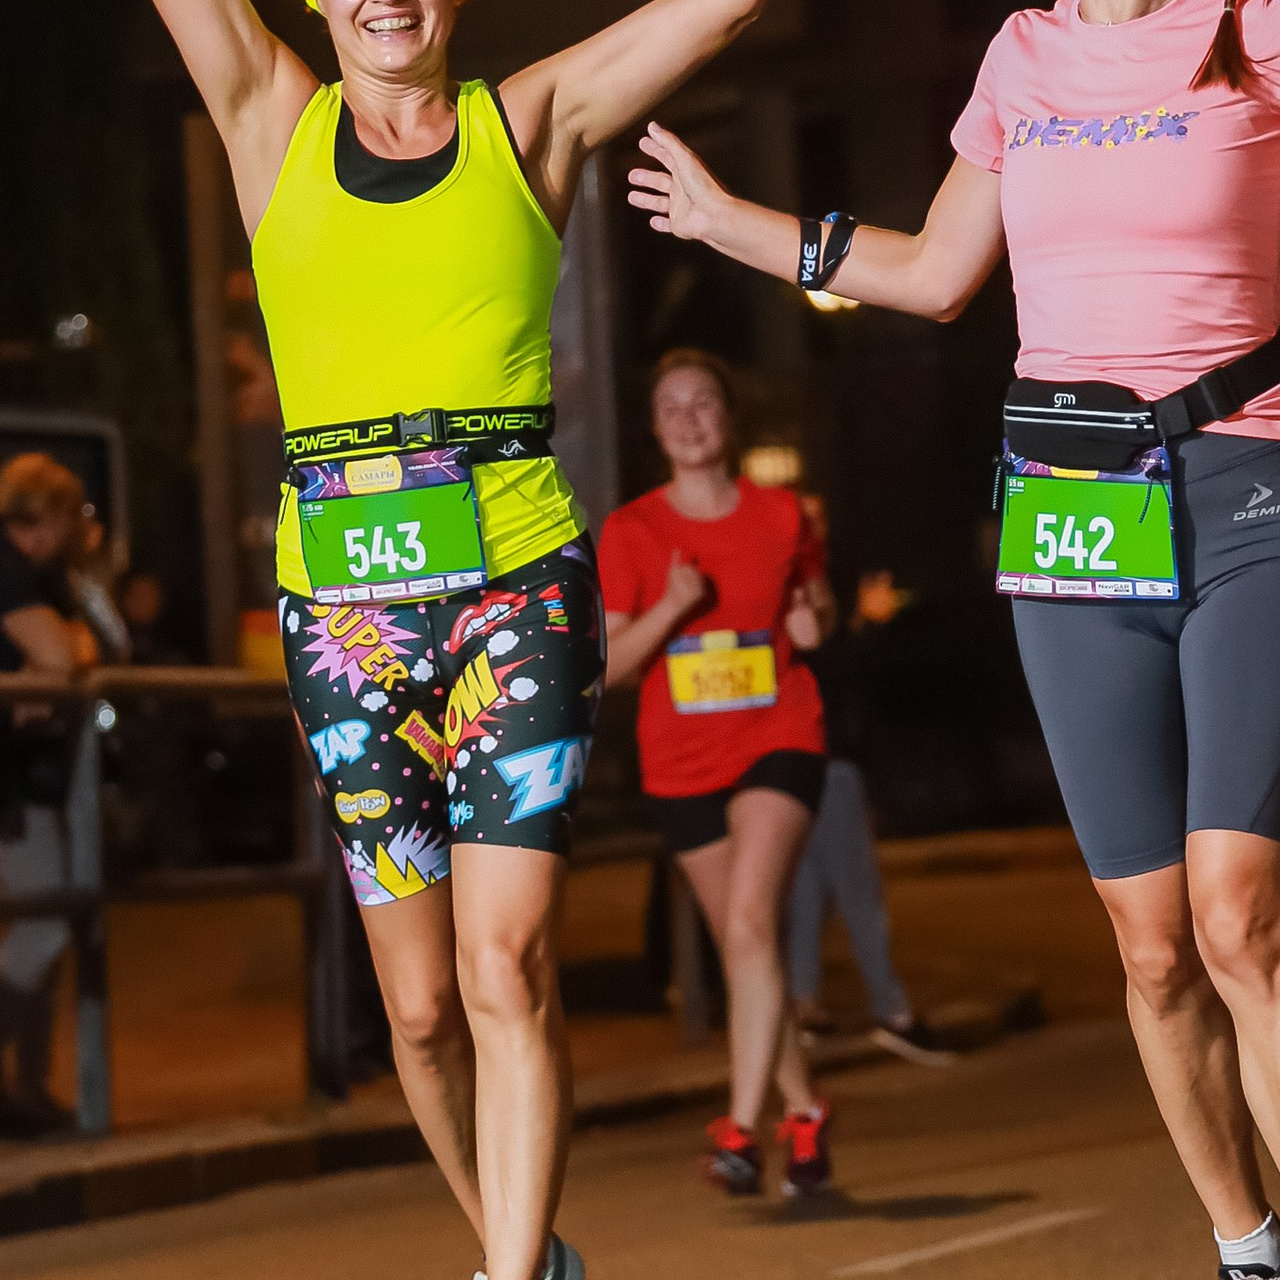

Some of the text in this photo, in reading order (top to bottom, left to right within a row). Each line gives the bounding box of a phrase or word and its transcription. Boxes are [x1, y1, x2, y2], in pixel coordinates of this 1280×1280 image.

[1009, 111, 1200, 151] DEMIX
[1054, 392, 1076, 407] gm
[285, 413, 548, 455] POWERUP POWERU
[344, 520, 427, 579] 543
[1034, 513, 1117, 571] 542
[312, 722, 368, 772] ZAP
